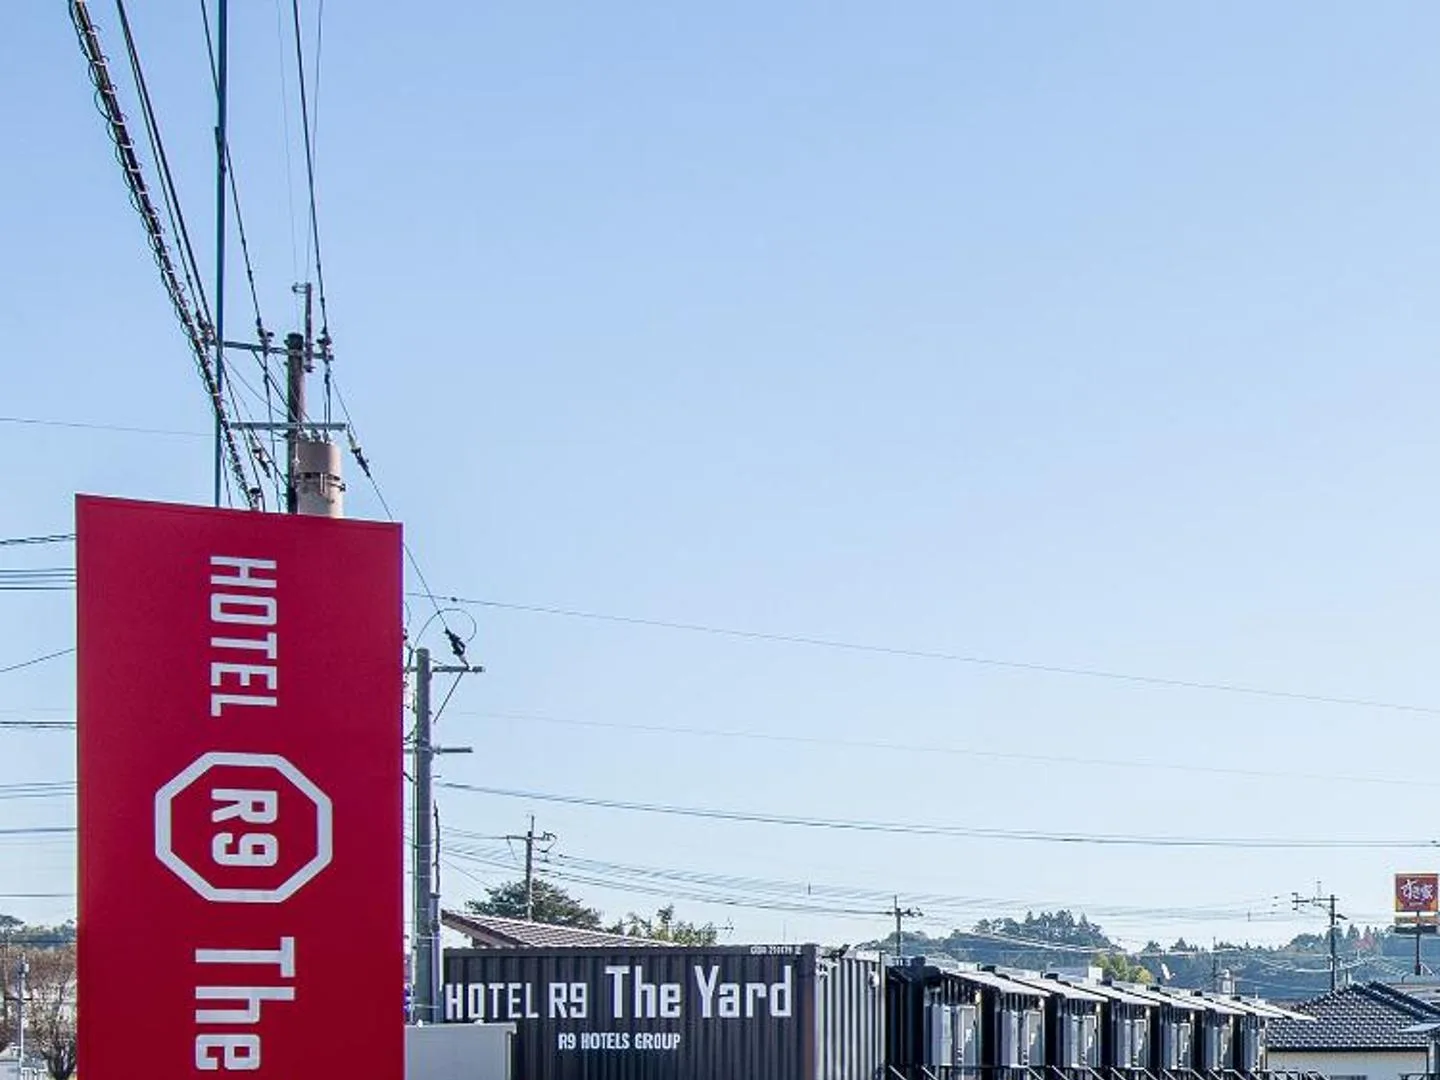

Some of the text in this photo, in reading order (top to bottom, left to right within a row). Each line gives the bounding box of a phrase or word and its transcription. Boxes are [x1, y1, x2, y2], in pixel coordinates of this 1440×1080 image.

[210, 556, 277, 717] HOTEL
[211, 788, 278, 867] R9
[195, 936, 295, 1070] The
[445, 965, 792, 1020] HOTEL R9 The Yard
[558, 1032, 681, 1050] R9 HOTELS GROUP
